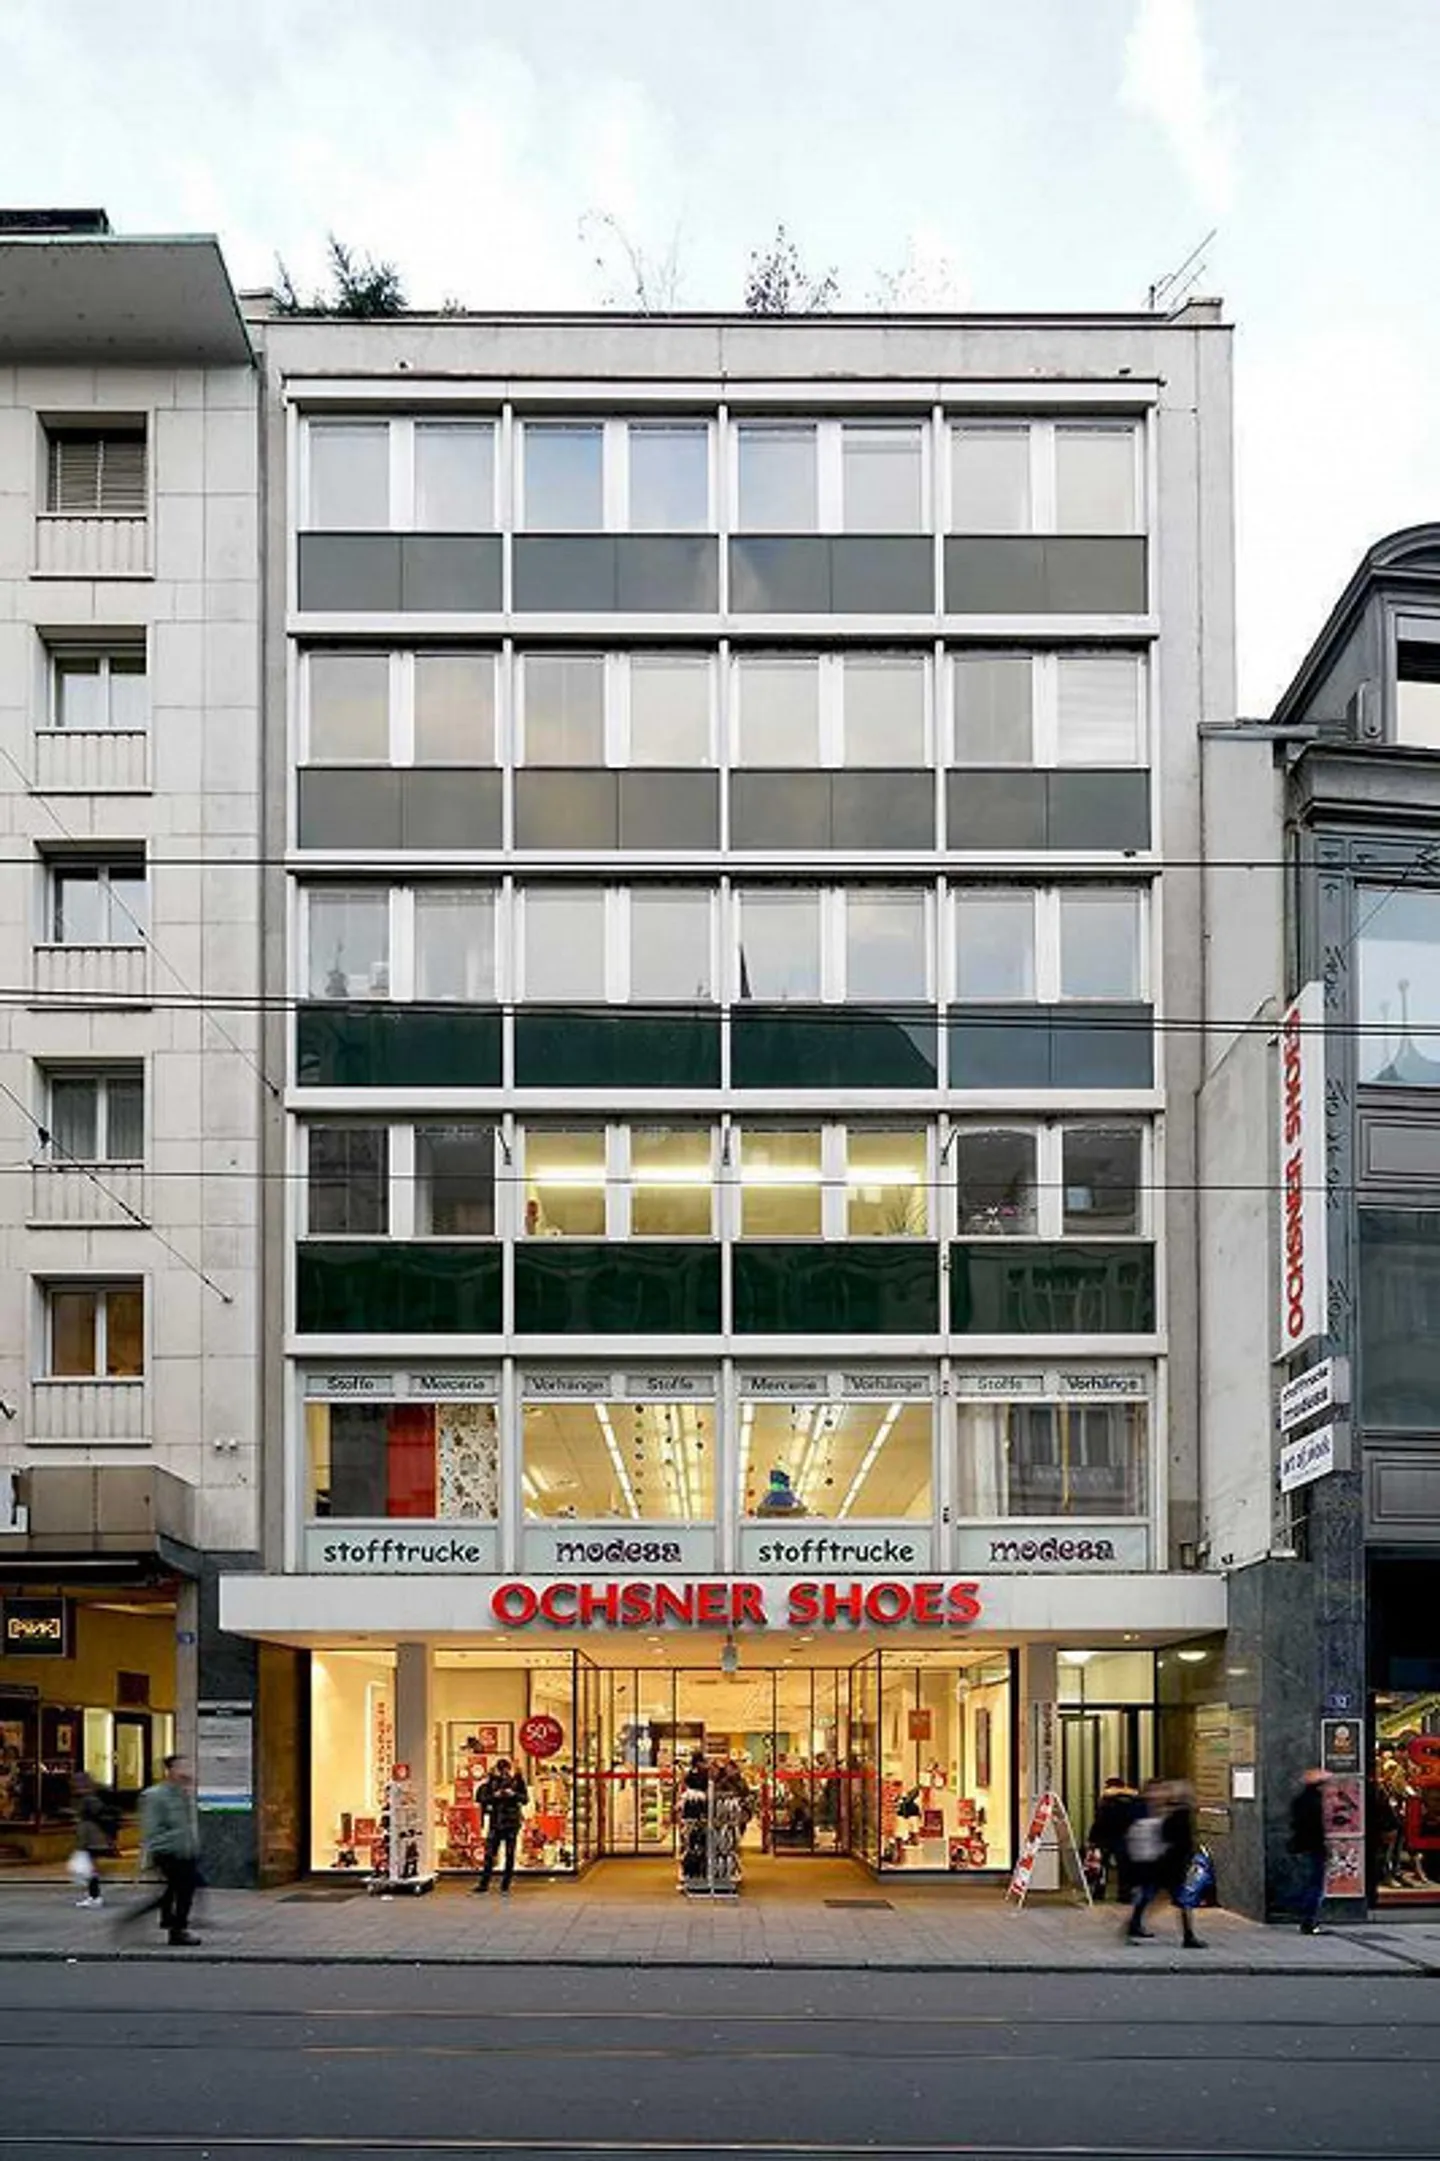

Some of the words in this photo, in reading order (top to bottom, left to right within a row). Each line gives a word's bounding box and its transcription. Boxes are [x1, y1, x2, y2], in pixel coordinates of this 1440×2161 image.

[1286, 1148, 1303, 1338] OCHSNER
[324, 1538, 480, 1563] stofftrucke
[556, 1538, 682, 1563] modesa
[759, 1538, 914, 1563] stofftrucke
[989, 1537, 1114, 1562] modesa
[491, 1583, 767, 1626] OCHSNER
[788, 1583, 982, 1625] SHOES
